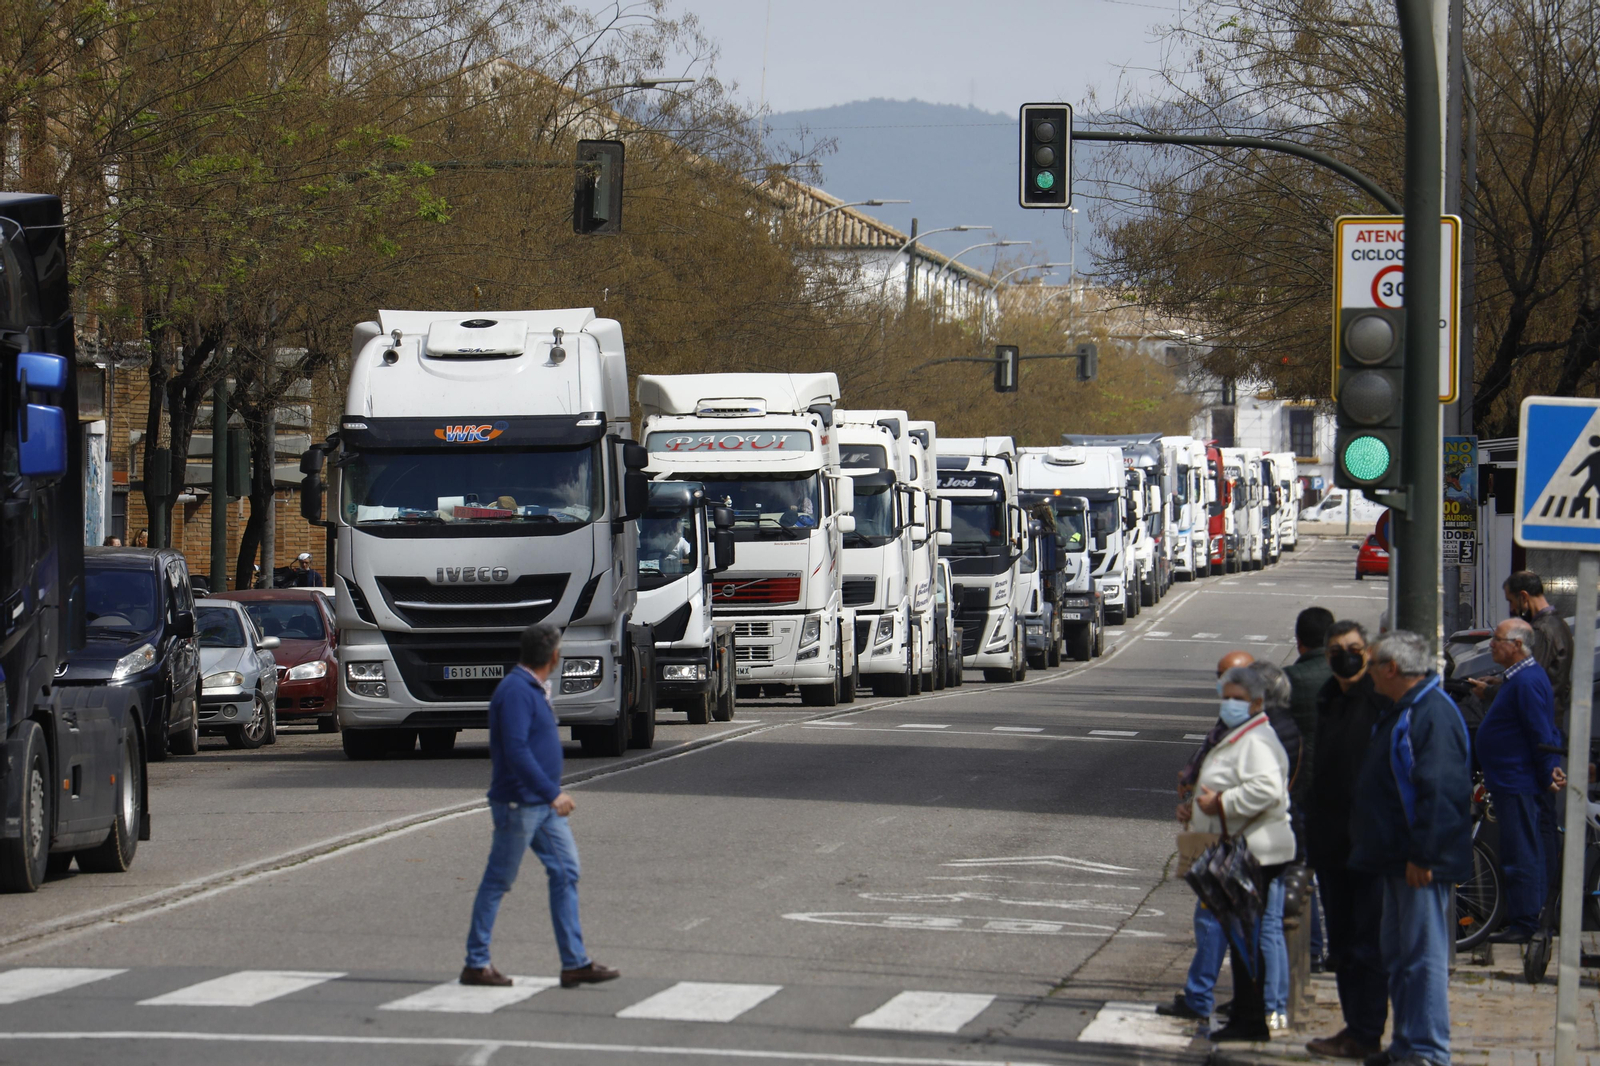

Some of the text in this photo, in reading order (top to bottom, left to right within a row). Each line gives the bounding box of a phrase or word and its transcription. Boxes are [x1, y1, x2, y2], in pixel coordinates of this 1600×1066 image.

[1355, 230, 1404, 243] ATENC
[1351, 249, 1404, 261] CICLOC
[665, 434, 792, 451] PAQUI
[1445, 441, 1472, 453] NO
[1443, 501, 1460, 514] 00
[1443, 531, 1475, 540] RDOBA
[1462, 547, 1472, 559] 3
[436, 566, 509, 582] IVECO
[451, 666, 502, 678] 6181 KNM
